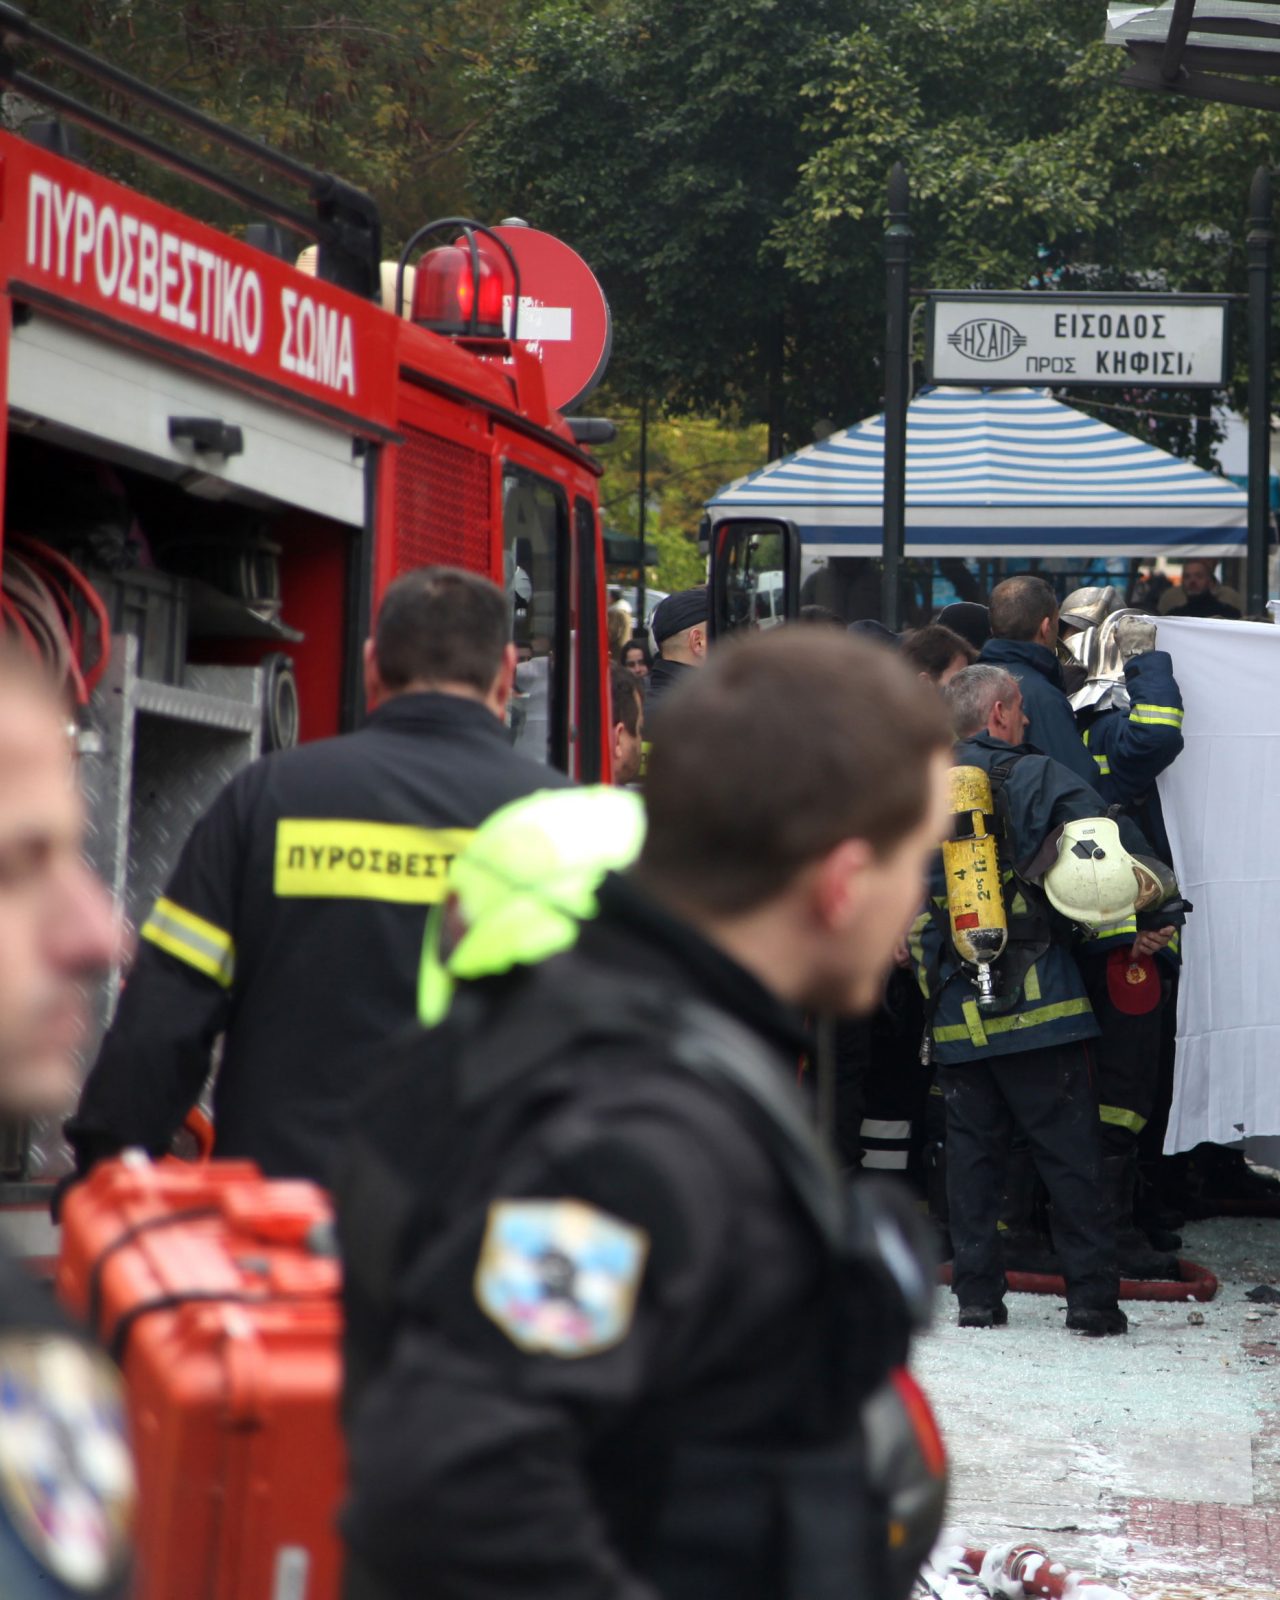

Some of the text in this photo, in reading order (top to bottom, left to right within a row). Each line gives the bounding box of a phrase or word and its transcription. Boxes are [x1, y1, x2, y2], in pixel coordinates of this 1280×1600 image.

[27, 173, 355, 396] ΠΥΡΟΣΒΕΣΤΙΚΟ ΣΩΜΑ
[963, 322, 1011, 358] ΗΣΑΠ
[1054, 313, 1167, 339] ΕΙΣΟΔΟΣ
[1026, 356, 1077, 374] ΠΡΟΣ
